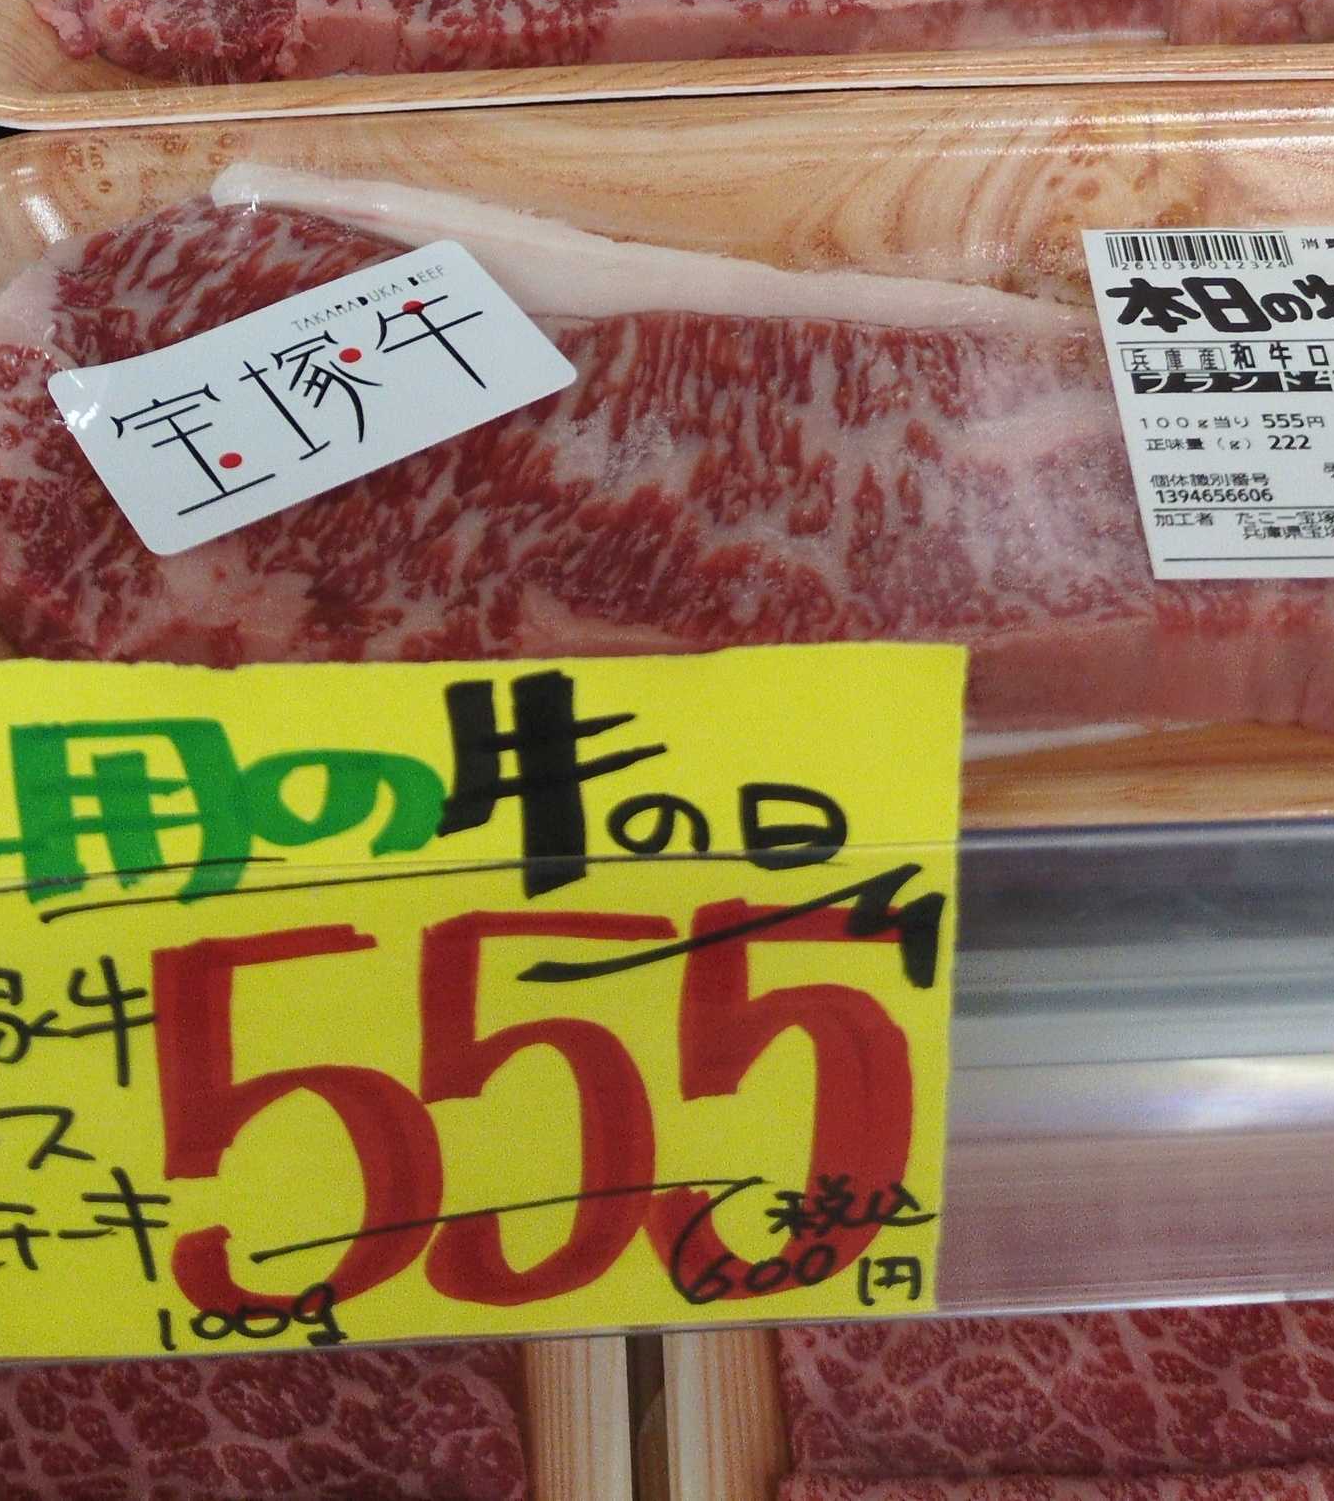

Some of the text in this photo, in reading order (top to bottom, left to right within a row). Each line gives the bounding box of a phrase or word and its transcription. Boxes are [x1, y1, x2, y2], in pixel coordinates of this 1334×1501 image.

[1121, 261, 1288, 271] 261036012324
[290, 264, 445, 332] TAKARADUKA BEEF
[110, 295, 487, 516] 宝塚牛
[1261, 413, 1326, 429] 555円
[1267, 434, 1313, 451] 222
[1155, 488, 1274, 504] 1394656606
[151, 899, 914, 1318] 555
